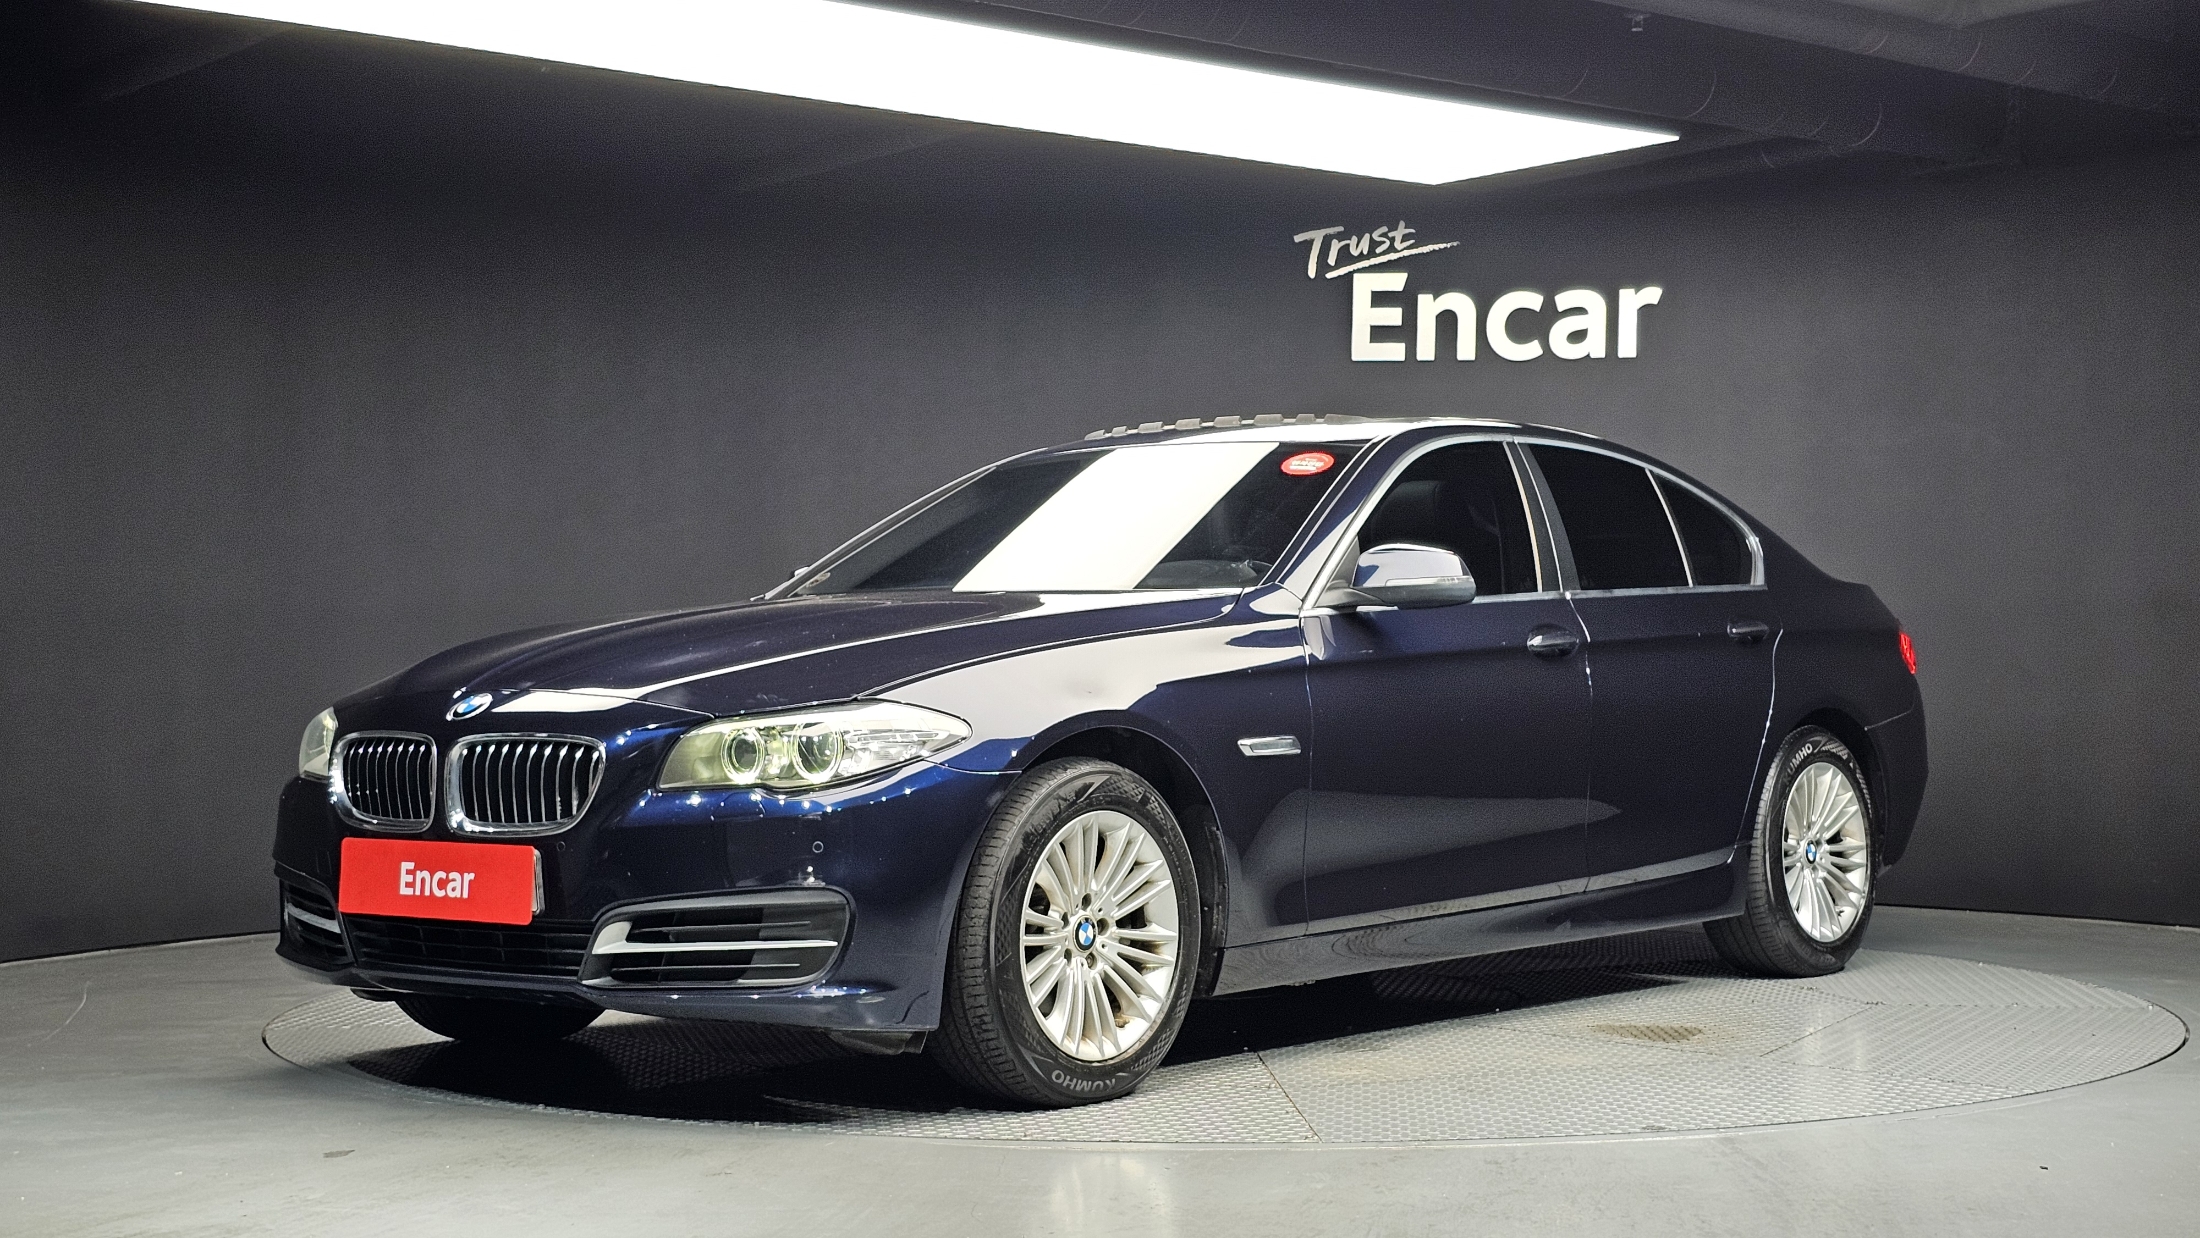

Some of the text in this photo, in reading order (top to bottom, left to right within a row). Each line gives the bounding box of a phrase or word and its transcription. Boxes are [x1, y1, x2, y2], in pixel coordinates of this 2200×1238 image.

[1294, 220, 1416, 279] Trust
[1351, 272, 1663, 361] Encar
[399, 861, 475, 898] Encar
[1051, 1069, 1116, 1093] KUMHO
